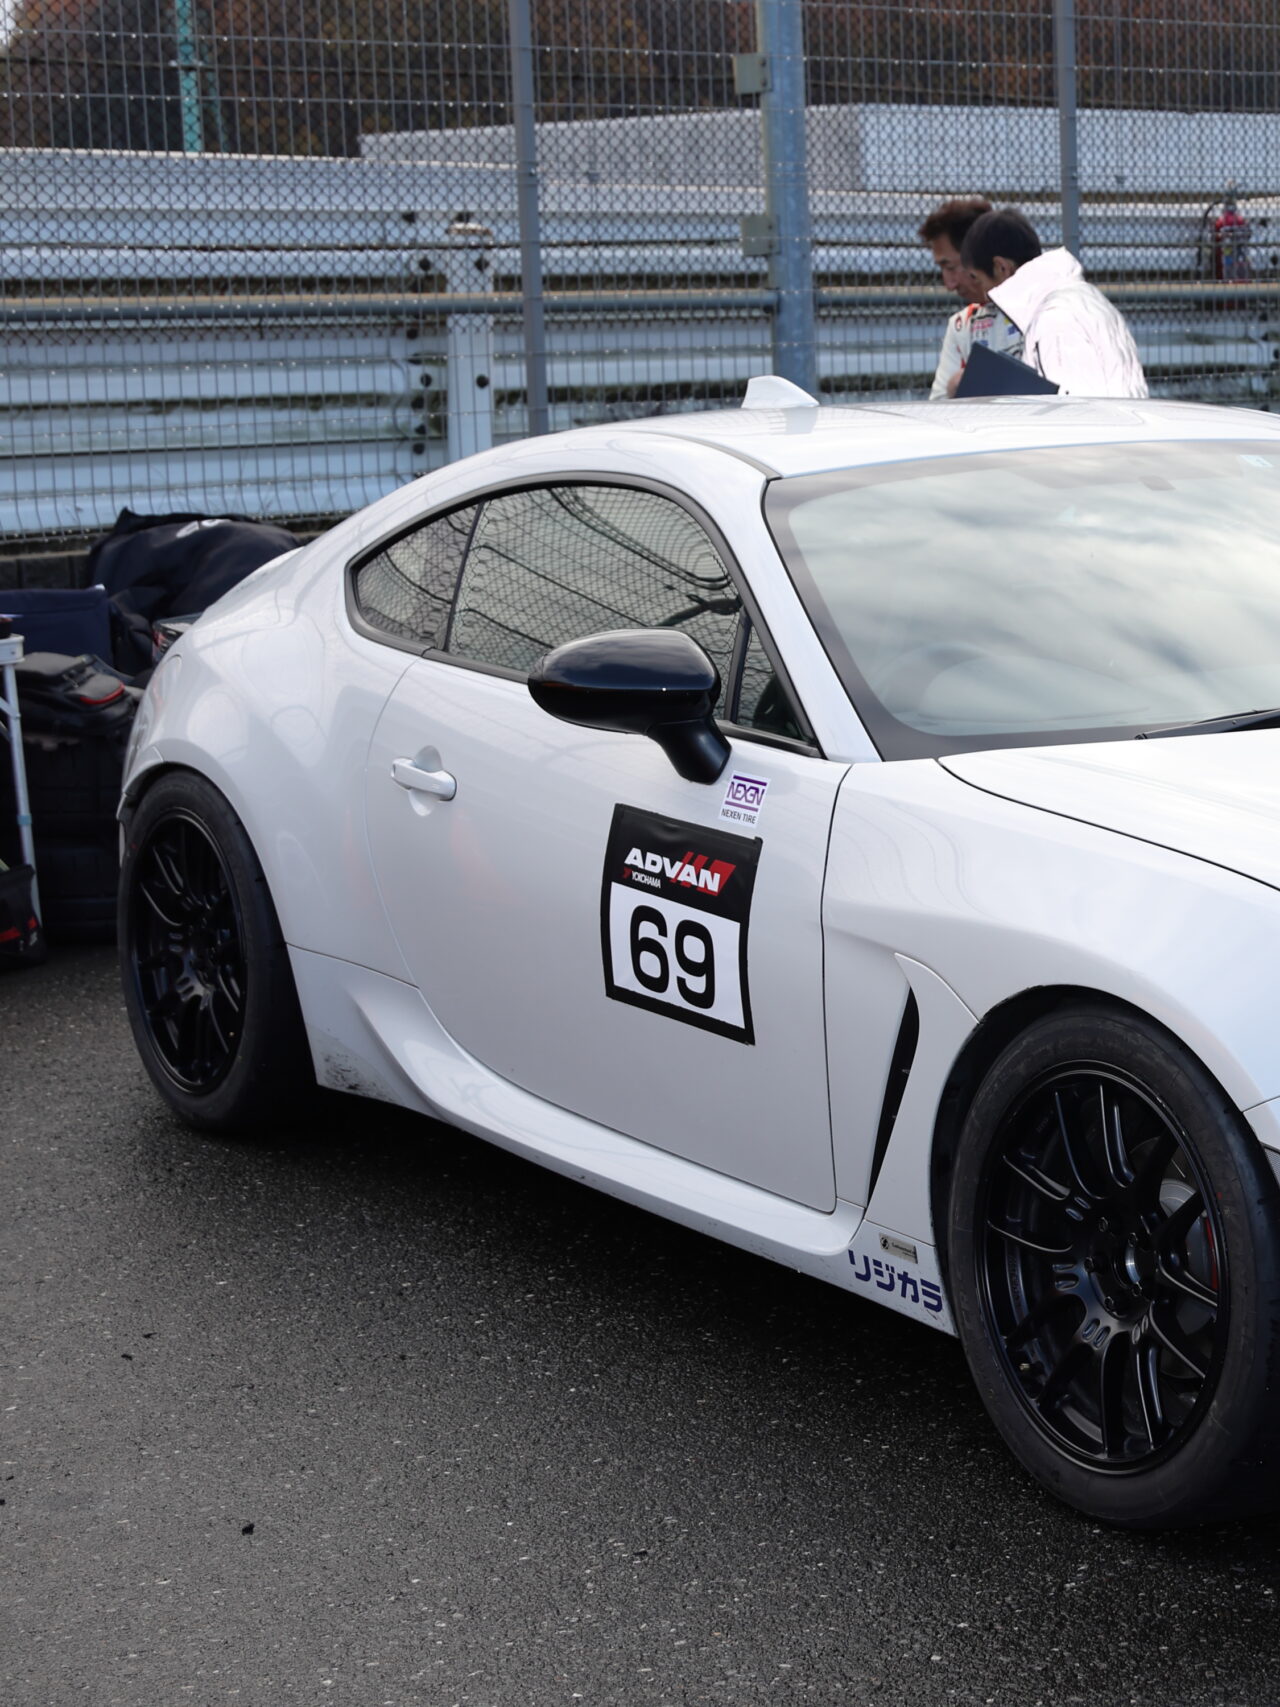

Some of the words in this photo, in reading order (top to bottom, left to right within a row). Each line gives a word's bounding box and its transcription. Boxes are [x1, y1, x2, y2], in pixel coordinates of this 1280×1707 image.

[721, 808, 742, 821] NEXEN
[742, 813, 757, 825] TIRE
[727, 781, 765, 806] NEXEN
[624, 847, 721, 893] ADVAN
[630, 904, 716, 1010] 69
[848, 1249, 943, 1313] リジカラ
